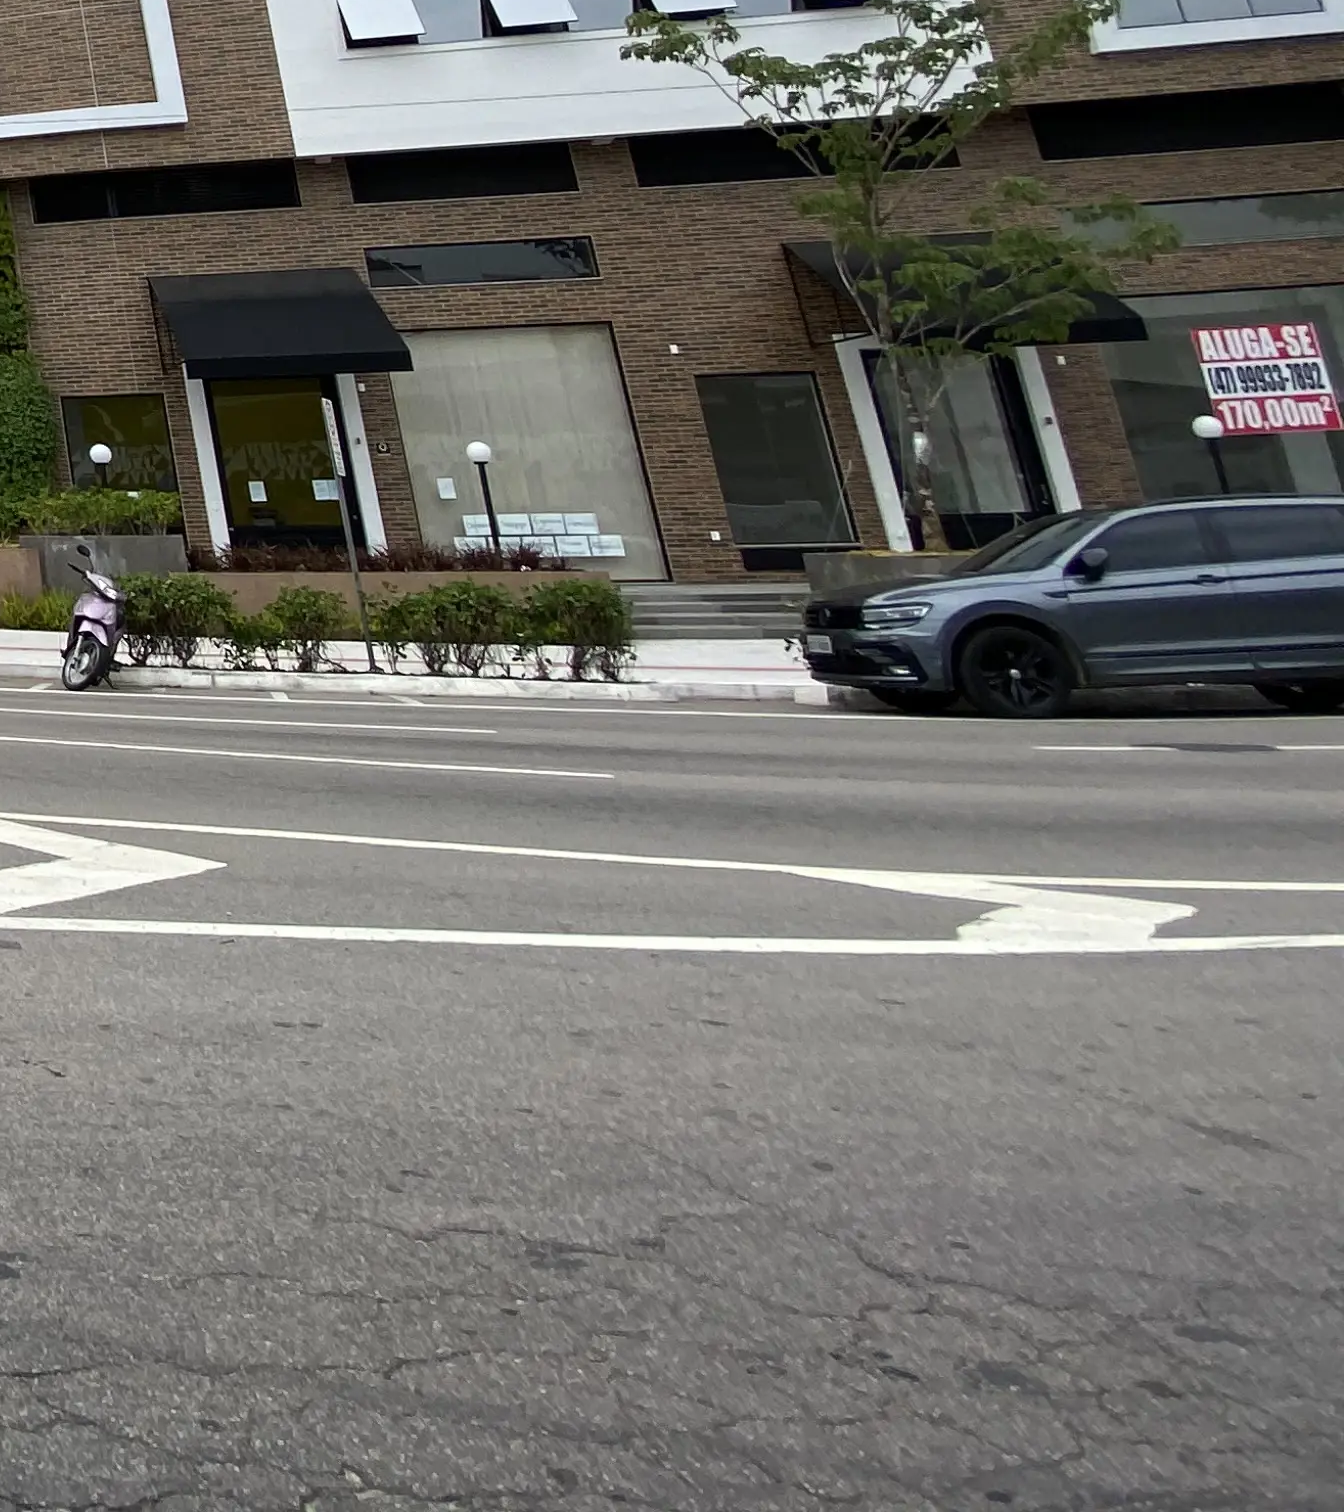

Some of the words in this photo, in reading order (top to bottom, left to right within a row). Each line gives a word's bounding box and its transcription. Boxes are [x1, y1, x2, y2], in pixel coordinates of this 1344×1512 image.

[1198, 325, 1316, 361] ALUGA-SE
[1208, 366, 1238, 394] (47)
[1237, 362, 1325, 392] 99933-7892
[1217, 396, 1333, 430] 170,00m²
